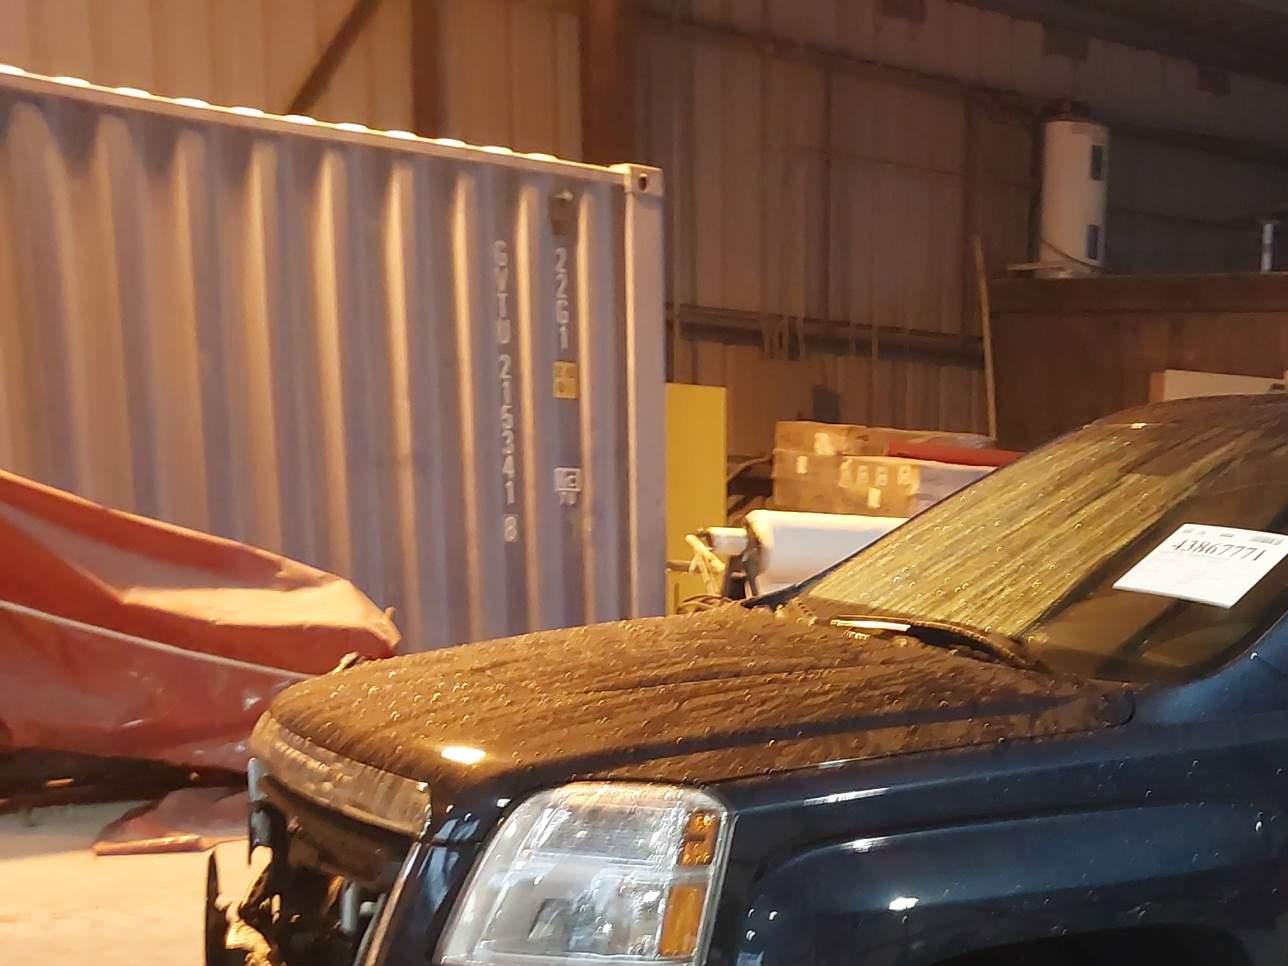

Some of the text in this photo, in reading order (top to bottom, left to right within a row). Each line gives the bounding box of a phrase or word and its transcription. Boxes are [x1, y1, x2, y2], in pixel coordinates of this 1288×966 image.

[555, 247, 569, 349] 22G1
[499, 354, 516, 505] 215341
[503, 516, 518, 543] 8
[1172, 539, 1268, 562] 43867771
